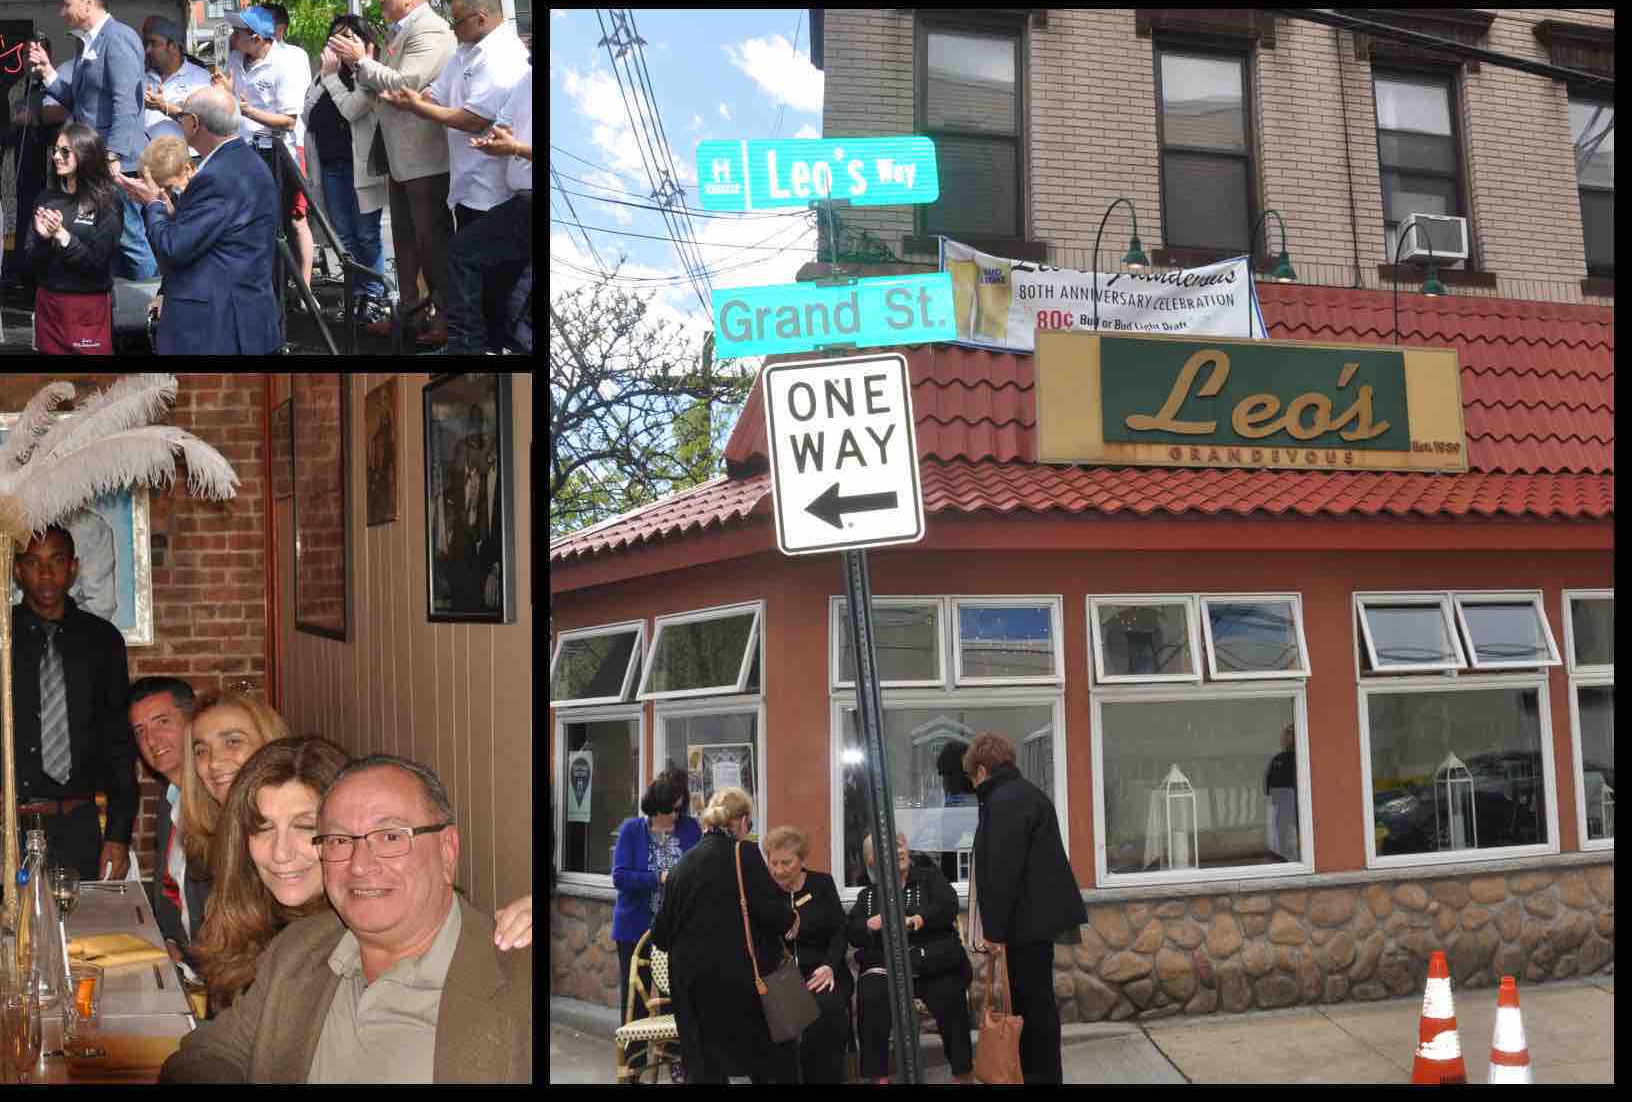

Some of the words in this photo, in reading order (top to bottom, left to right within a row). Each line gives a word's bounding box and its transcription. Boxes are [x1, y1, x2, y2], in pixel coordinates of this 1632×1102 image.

[768, 147, 869, 198] Leo's
[719, 290, 862, 342] Grand
[884, 284, 947, 330] St.
[1019, 284, 1054, 300] 80TH
[1059, 285, 1153, 310] ANNIVERSARY
[1153, 293, 1235, 311] CELEBRATION
[787, 374, 891, 422] ONE
[1125, 349, 1391, 442] Leo's
[789, 424, 896, 474] WAY
[1169, 446, 1354, 465] GRANDEVOUS
